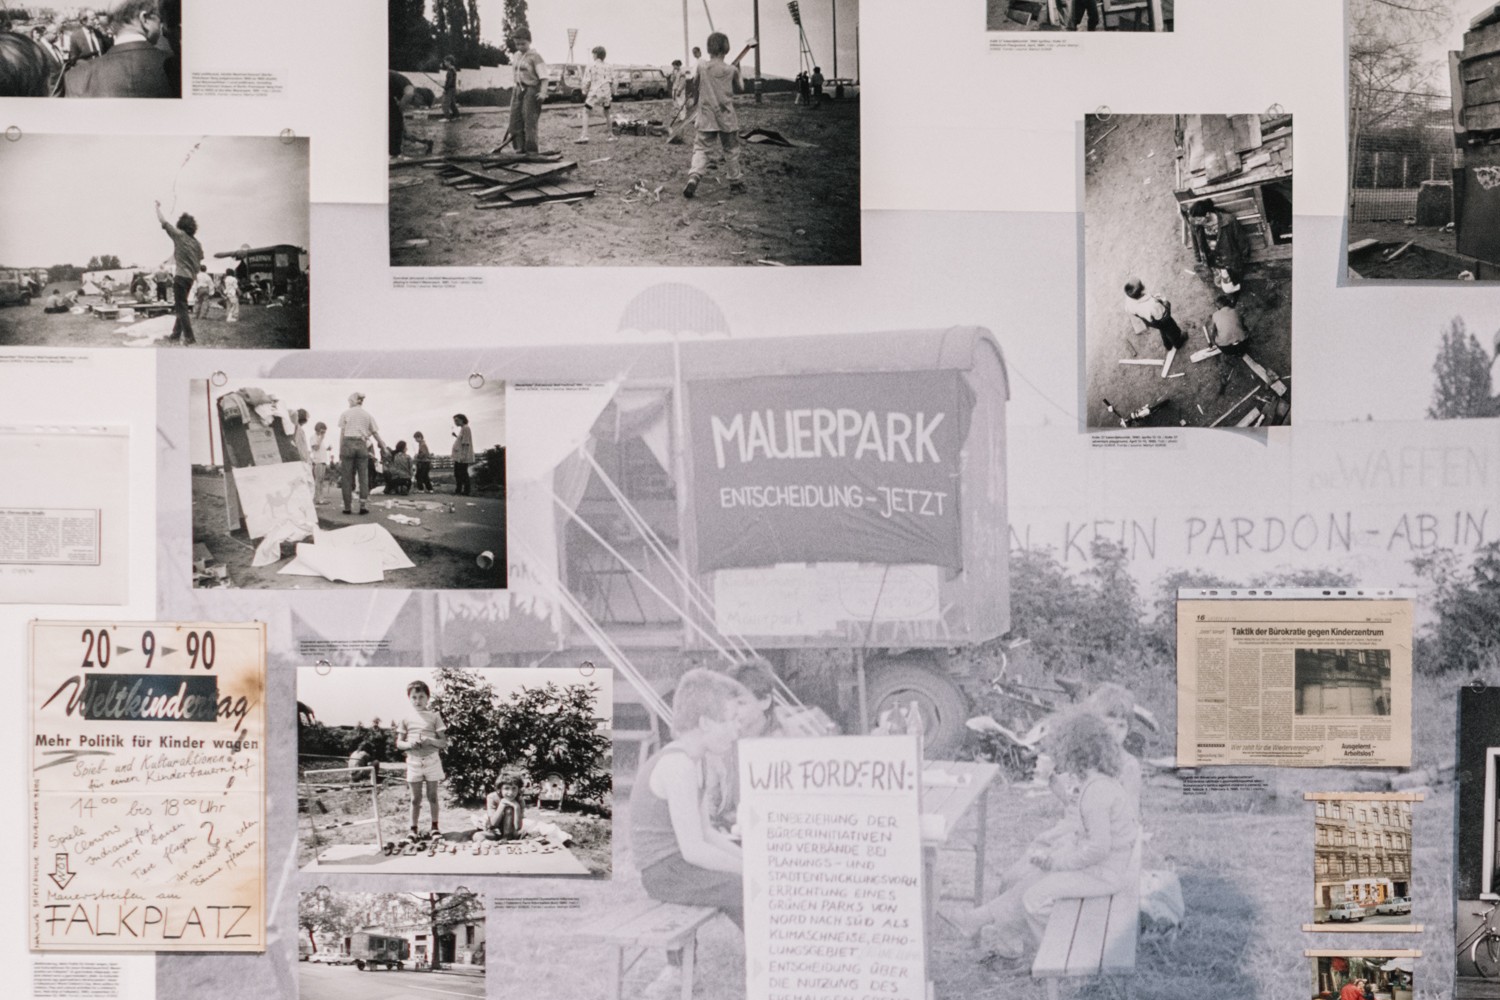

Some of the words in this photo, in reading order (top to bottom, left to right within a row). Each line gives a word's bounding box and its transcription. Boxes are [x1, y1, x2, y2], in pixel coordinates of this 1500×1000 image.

[710, 407, 947, 470] MAUERPARK
[1453, 509, 1491, 546] IN
[1231, 627, 1256, 636] Taktik
[1256, 627, 1268, 636] der
[1268, 627, 1307, 637] Bürokratie
[1307, 629, 1330, 638] gegen
[1330, 627, 1385, 637] Kinderzentrum
[81, 629, 111, 669] 20
[142, 630, 156, 669] 9
[186, 630, 216, 670] 90
[34, 734, 71, 748] Mehr
[78, 735, 125, 749] Politik
[132, 735, 152, 749] für
[159, 736, 205, 750] Kinder
[213, 740, 259, 753] wagen
[748, 760, 794, 791] WIR
[199, 798, 227, 815] Uhr
[866, 815, 899, 829] DER
[766, 842, 793, 853] UND
[866, 846, 888, 858] BEI
[846, 860, 876, 871] UND
[768, 884, 848, 899] ERRICHTUNG
[854, 889, 897, 901] EINES
[820, 901, 865, 913] PARKS
[870, 903, 899, 914] VON
[44, 903, 253, 939] FALKPLATZ
[769, 913, 807, 925] NORD
[809, 914, 842, 926] NACH
[845, 914, 875, 928] SÜD
[881, 918, 910, 929] ALS
[768, 960, 862, 975] ENTSCHEIDUNG
[870, 961, 909, 978] ÜBER
[768, 977, 791, 990] DIE
[796, 977, 860, 991] NUTZUNG
[870, 980, 899, 994] DES
